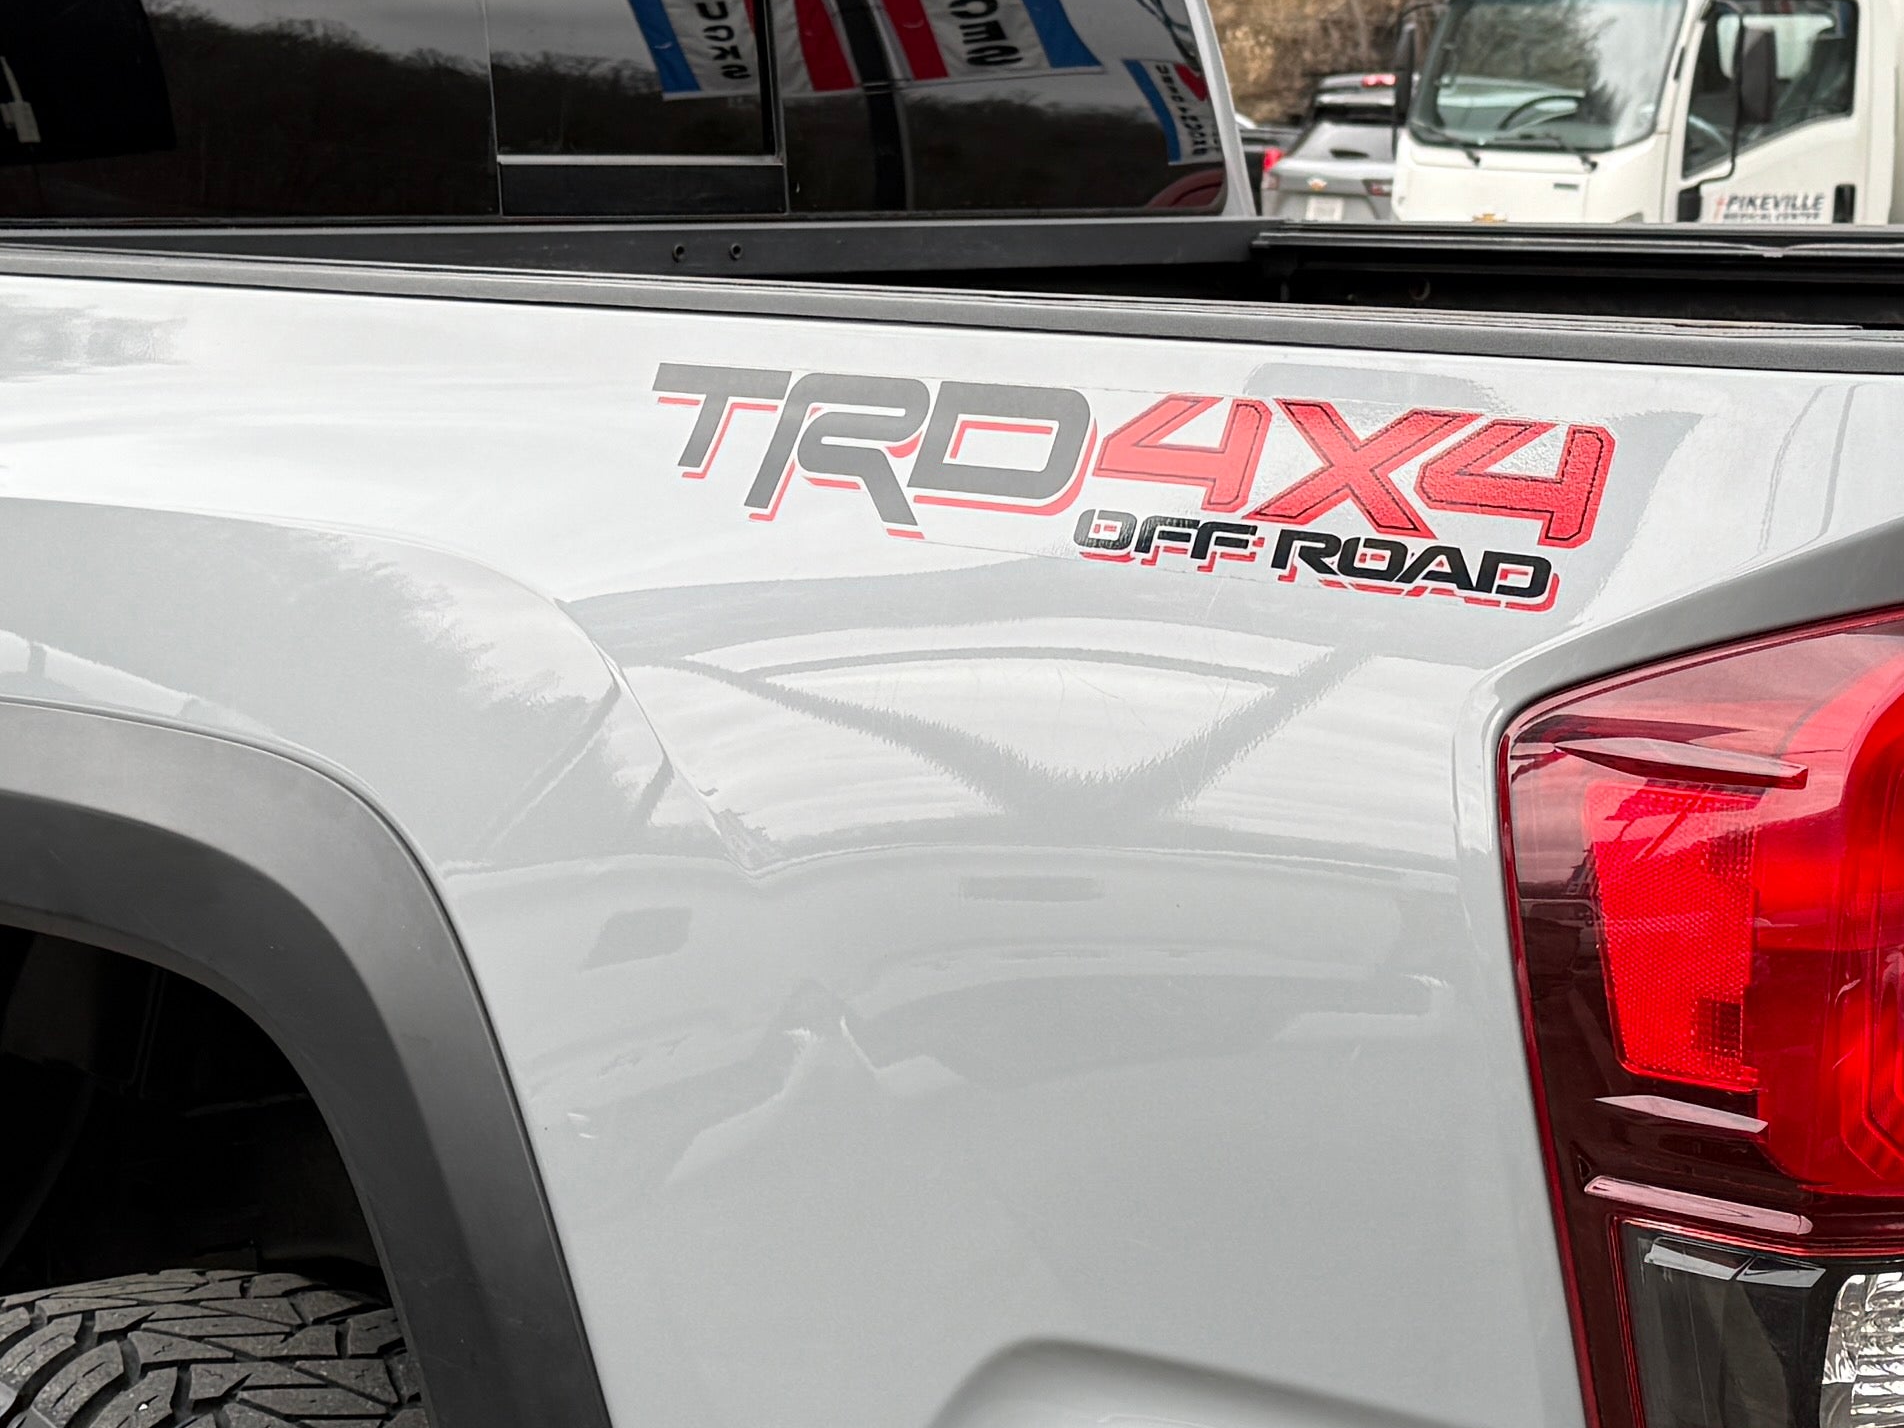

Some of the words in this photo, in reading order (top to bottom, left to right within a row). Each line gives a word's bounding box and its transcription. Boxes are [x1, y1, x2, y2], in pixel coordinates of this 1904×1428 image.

[652, 362, 1096, 538] TRD
[1093, 391, 1617, 547] 4X4
[1073, 507, 1264, 571] OFF
[1269, 529, 1558, 612] ROAD
